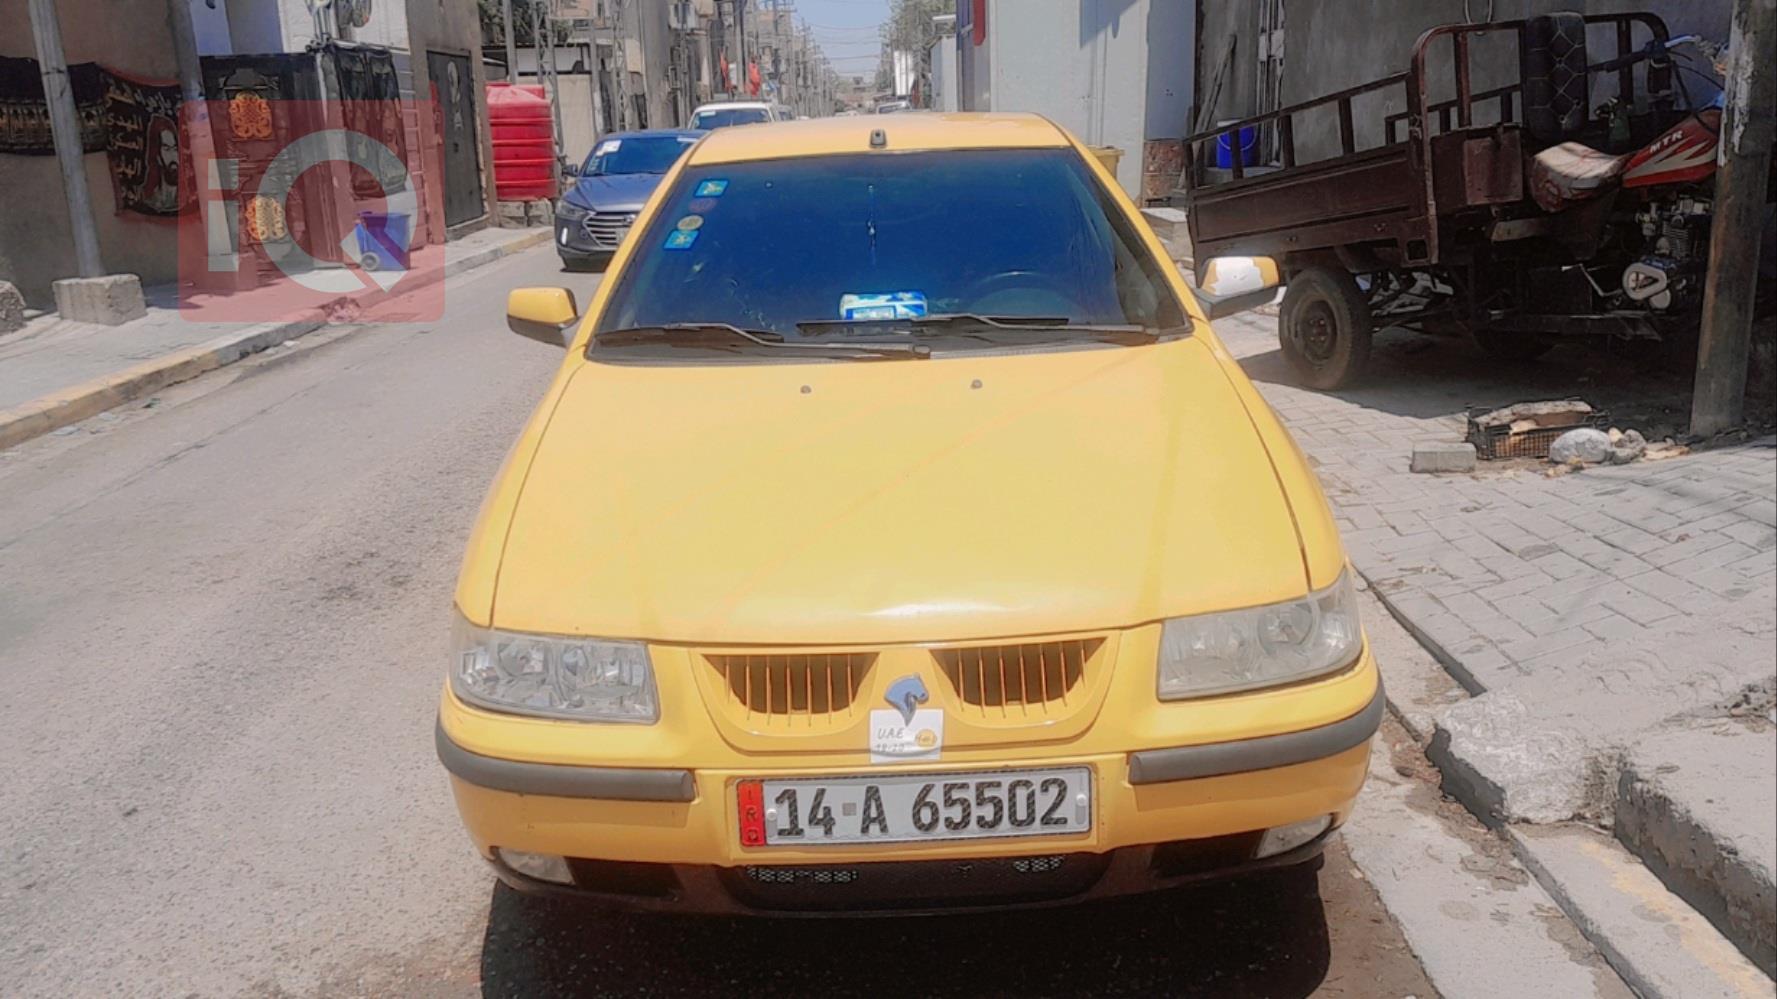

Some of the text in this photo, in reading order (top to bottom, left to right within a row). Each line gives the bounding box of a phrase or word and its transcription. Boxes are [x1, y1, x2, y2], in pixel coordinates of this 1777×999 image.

[1649, 130, 1683, 153] MTR
[877, 727, 905, 740] UAE
[745, 789, 760, 842] IRQ
[774, 777, 1069, 837] 14 A 65502
